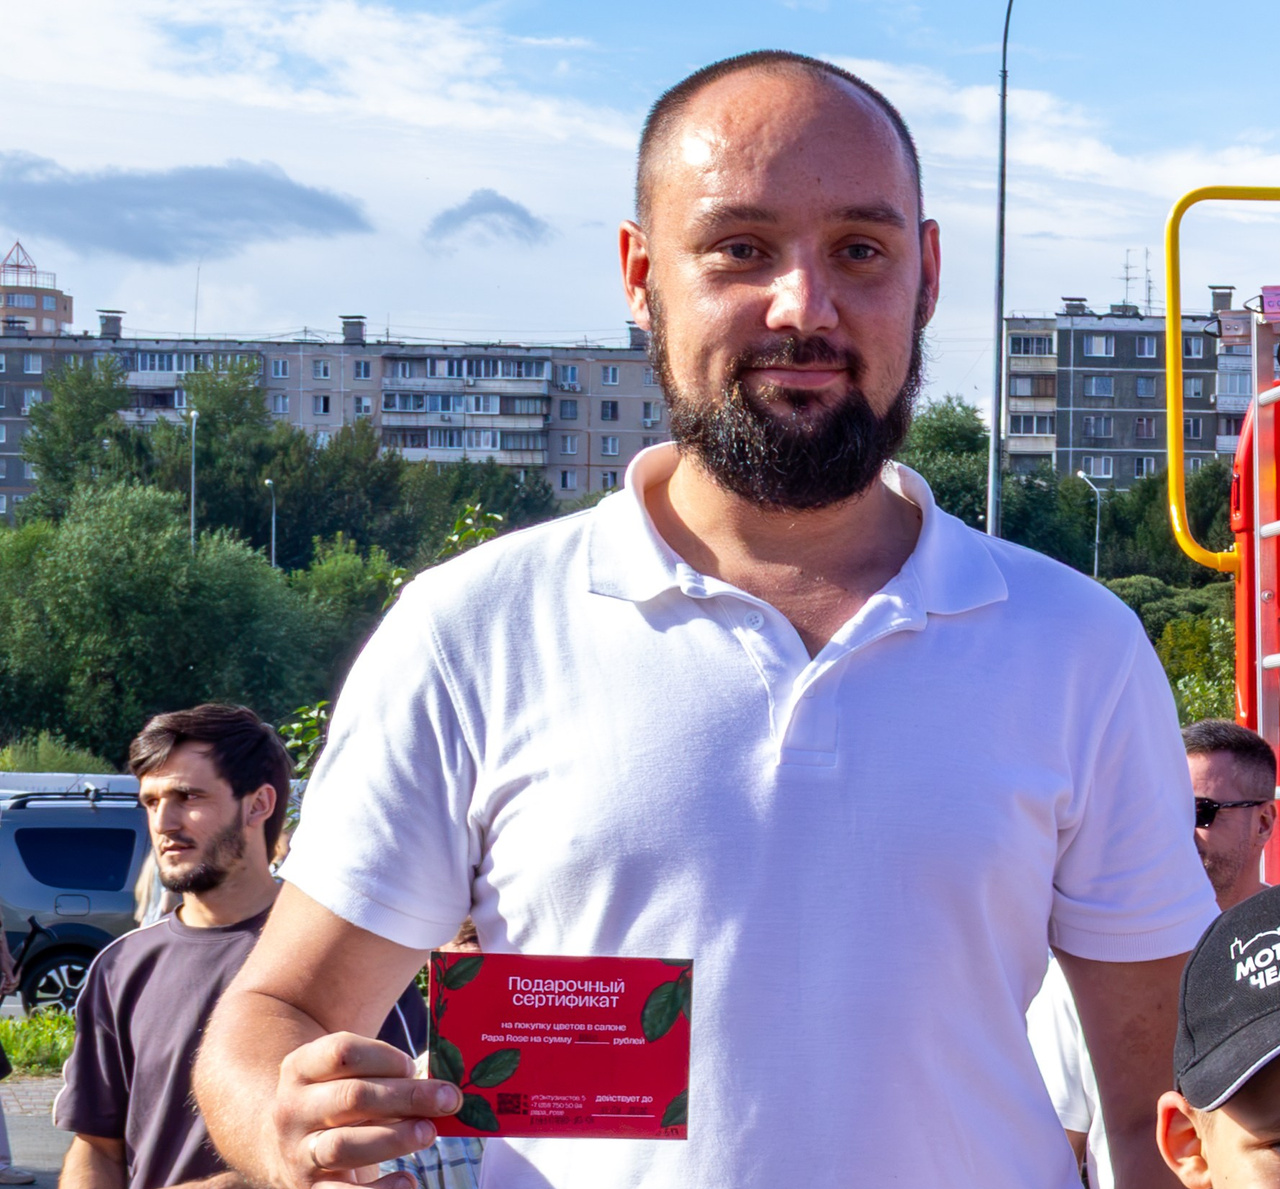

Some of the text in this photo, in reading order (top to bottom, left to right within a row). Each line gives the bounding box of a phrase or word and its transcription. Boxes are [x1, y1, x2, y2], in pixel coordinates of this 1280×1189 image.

[508, 976, 625, 993] Подарочный
[512, 993, 619, 1008] сертификат
[501, 1022, 512, 1030] на
[514, 1022, 551, 1032] покупку
[553, 1023, 585, 1032] цветов
[594, 1024, 627, 1032] салоне
[481, 1034, 504, 1044] Papa
[506, 1034, 529, 1042] Rose
[542, 1036, 572, 1045] сумму
[613, 1036, 645, 1046] рублей
[595, 1094, 653, 1104] действует до
